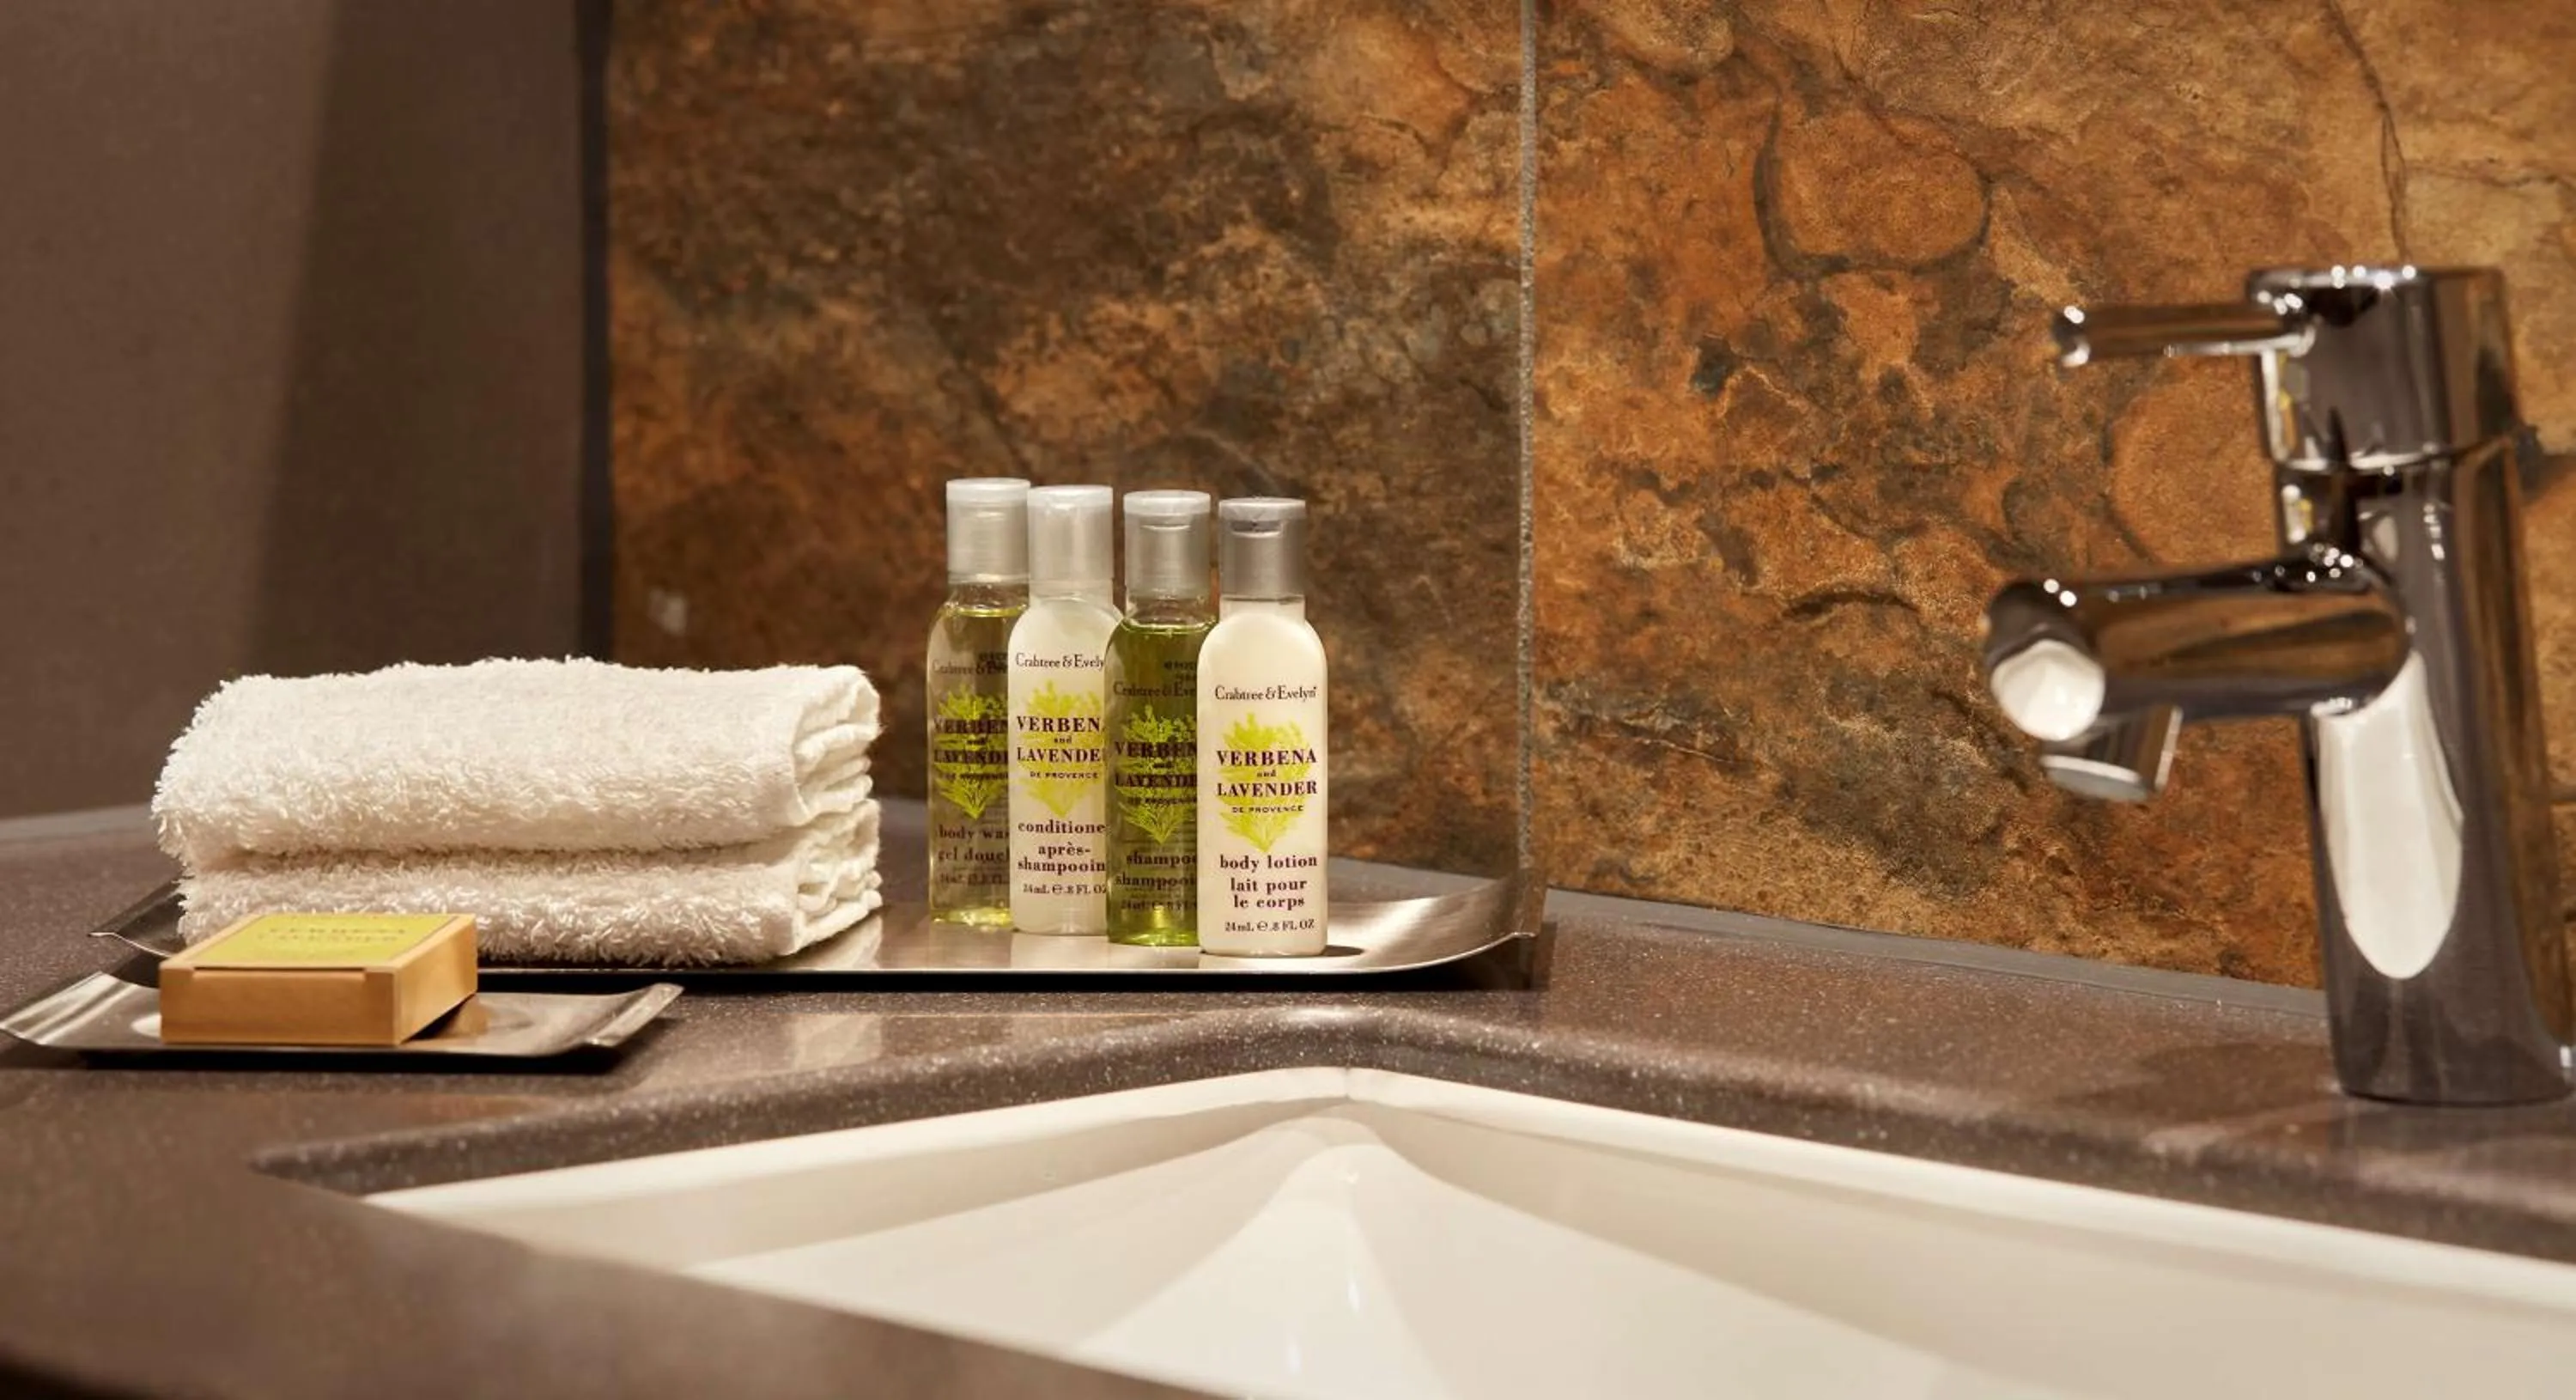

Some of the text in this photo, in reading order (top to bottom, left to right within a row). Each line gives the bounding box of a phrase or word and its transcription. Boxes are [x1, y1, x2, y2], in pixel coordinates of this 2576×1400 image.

[1016, 652, 1060, 668] Crabtree
[1061, 653, 1073, 669] &
[1215, 685, 1264, 700] Crabtree
[1265, 686, 1277, 700] &
[1054, 735, 1073, 744] and
[1017, 747, 1105, 763] LAVENDE
[1216, 748, 1317, 767] VERBENA
[1044, 771, 1099, 780] PROVENCE
[1256, 769, 1277, 778] and
[1217, 781, 1317, 798] LAVENDER
[1249, 805, 1304, 813] PROVENCE
[939, 825, 974, 843] body
[1037, 842, 1091, 856] après-
[1219, 854, 1318, 873] body lotion
[1230, 878, 1308, 895] lait pour
[1233, 895, 1305, 911] le corps
